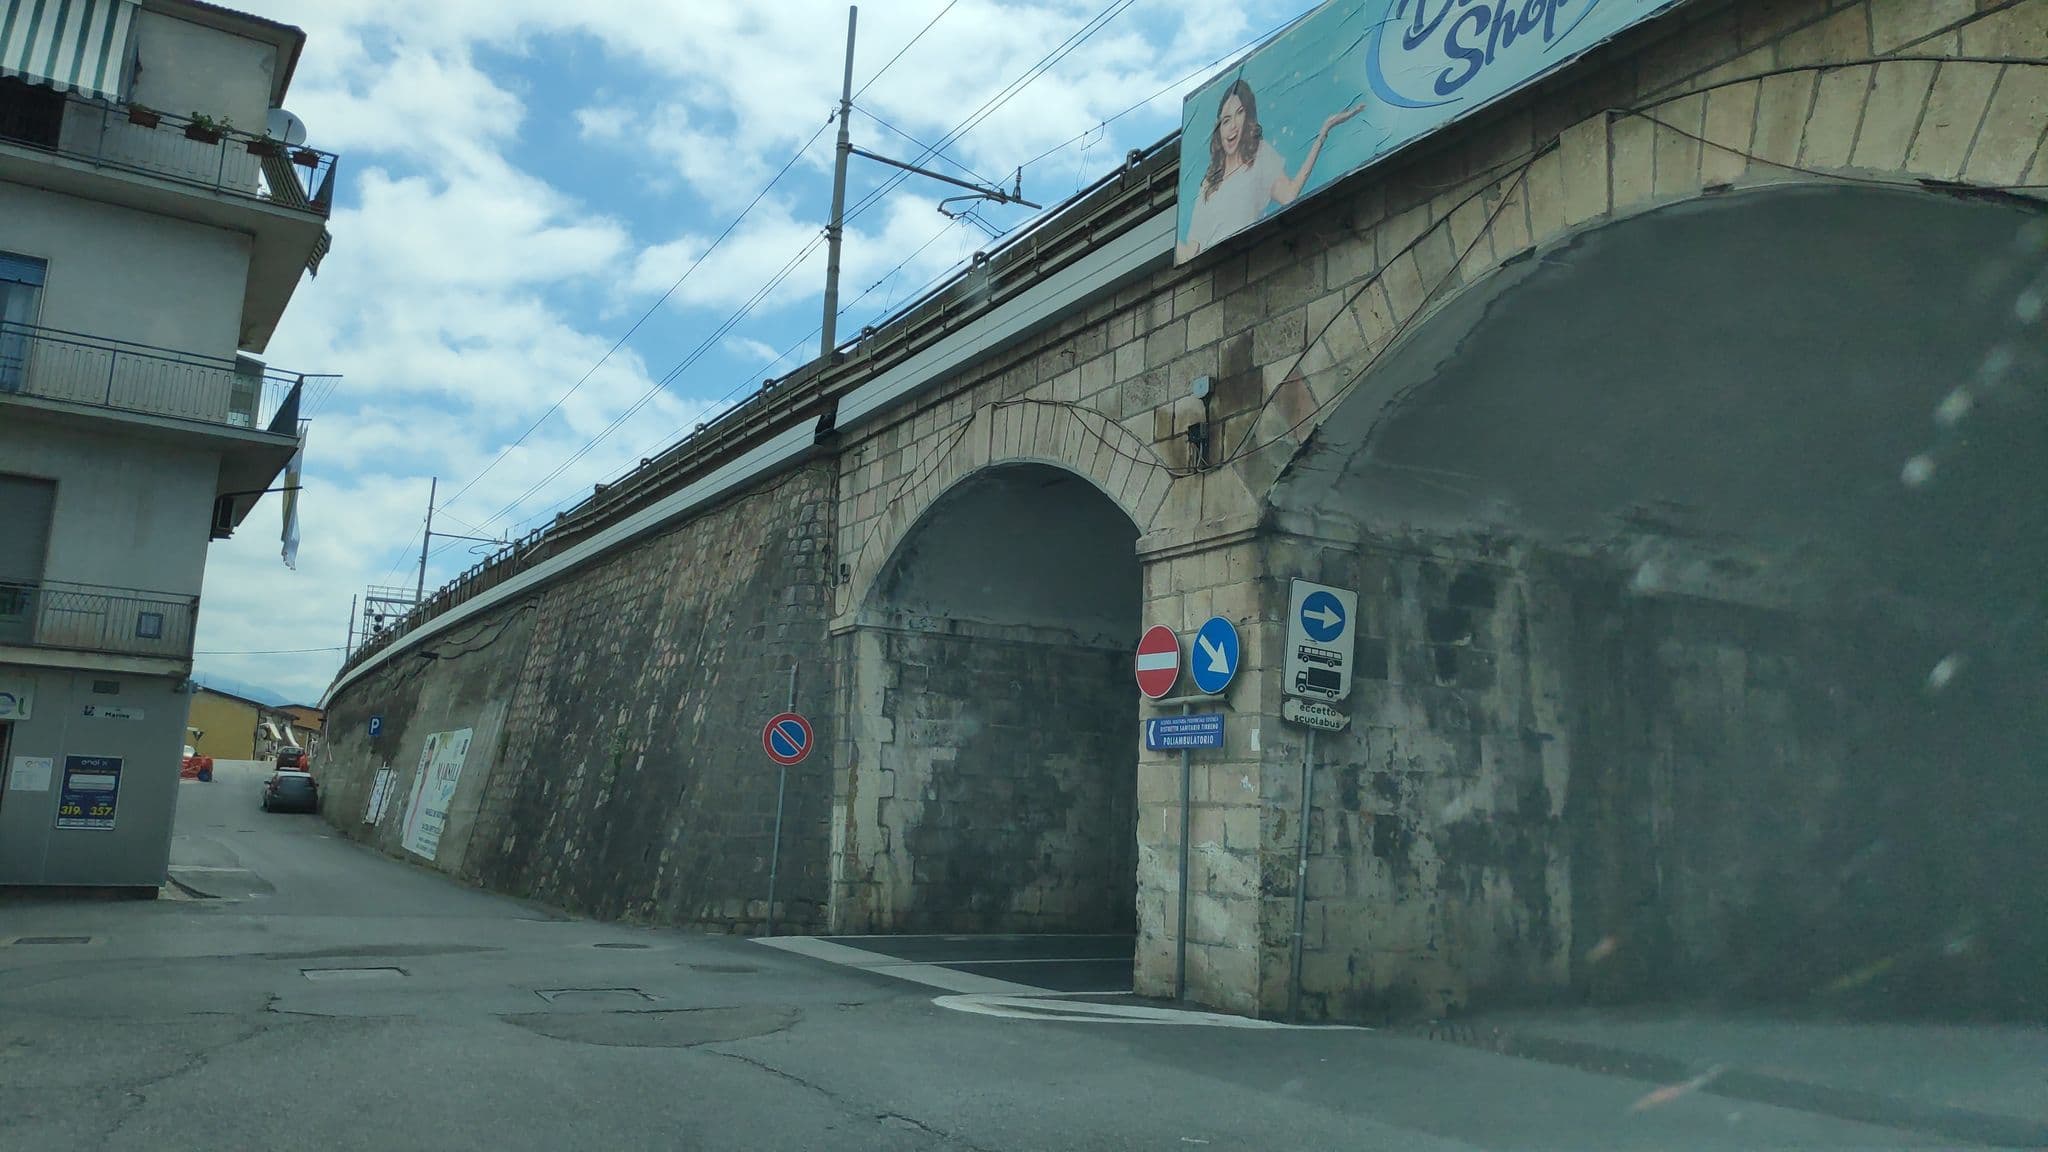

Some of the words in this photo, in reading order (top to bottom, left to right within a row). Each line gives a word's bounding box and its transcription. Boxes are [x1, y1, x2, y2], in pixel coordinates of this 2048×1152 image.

[1299, 704, 1336, 717] eccetto
[370, 718, 380, 734] P
[1294, 714, 1340, 728] scuolabus
[1160, 725, 1179, 733] DISTRETTO
[1163, 735, 1214, 746] POLIAMBULATORIO
